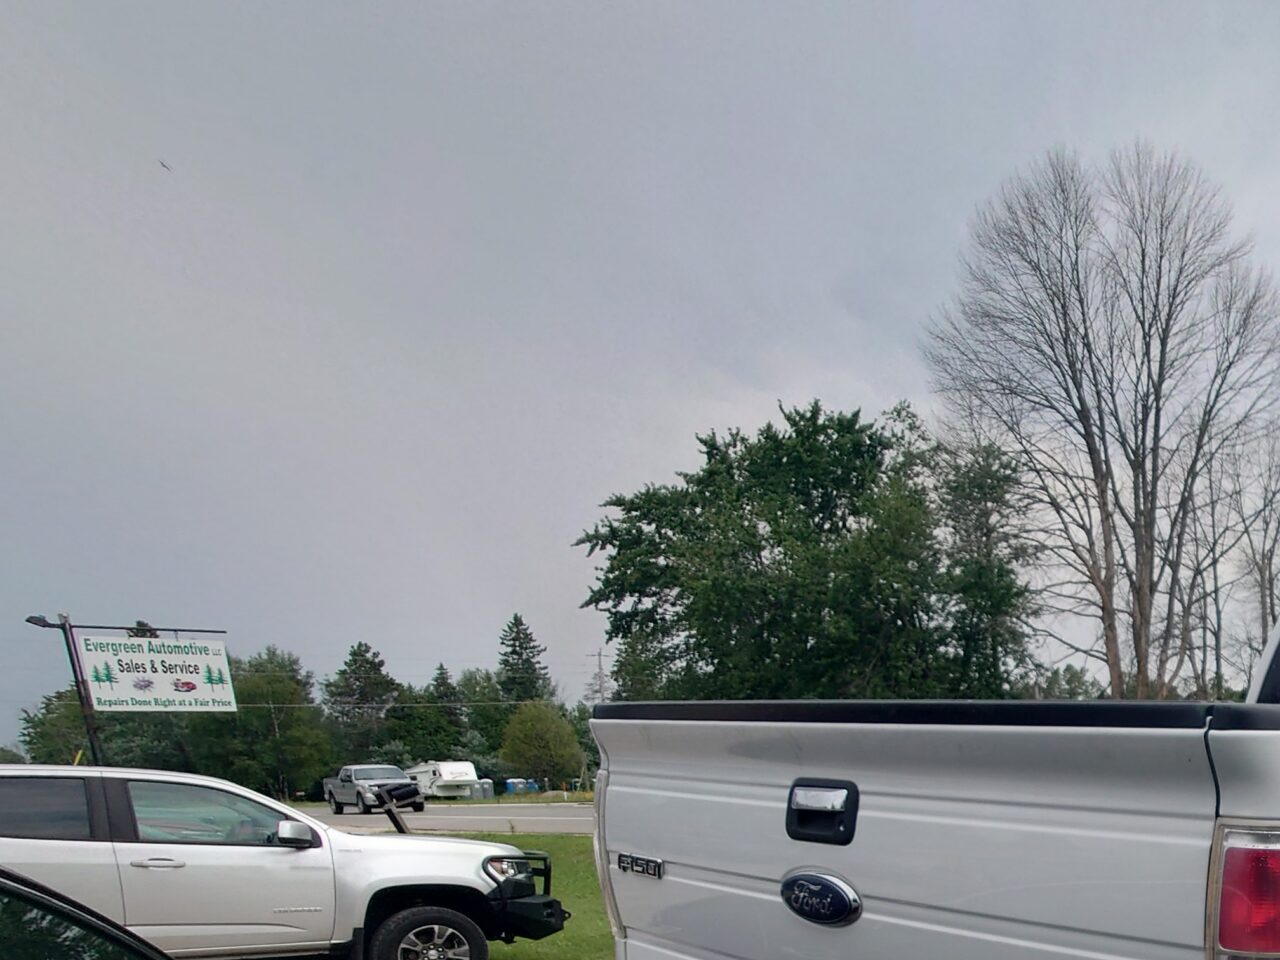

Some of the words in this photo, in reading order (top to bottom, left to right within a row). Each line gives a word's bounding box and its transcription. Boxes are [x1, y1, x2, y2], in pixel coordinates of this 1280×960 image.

[84, 638, 145, 656] Evergreen
[147, 640, 210, 656] Automotive
[117, 659, 147, 674] Sales
[150, 660, 159, 674] &
[160, 660, 200, 675] Service
[96, 697, 129, 708] Repairs
[131, 697, 151, 707] Done
[154, 698, 177, 709] Right
[178, 698, 186, 707] at
[189, 699, 193, 707] a
[194, 699, 210, 707] Fair
[211, 700, 233, 708] Price
[790, 880, 834, 915] Ford
